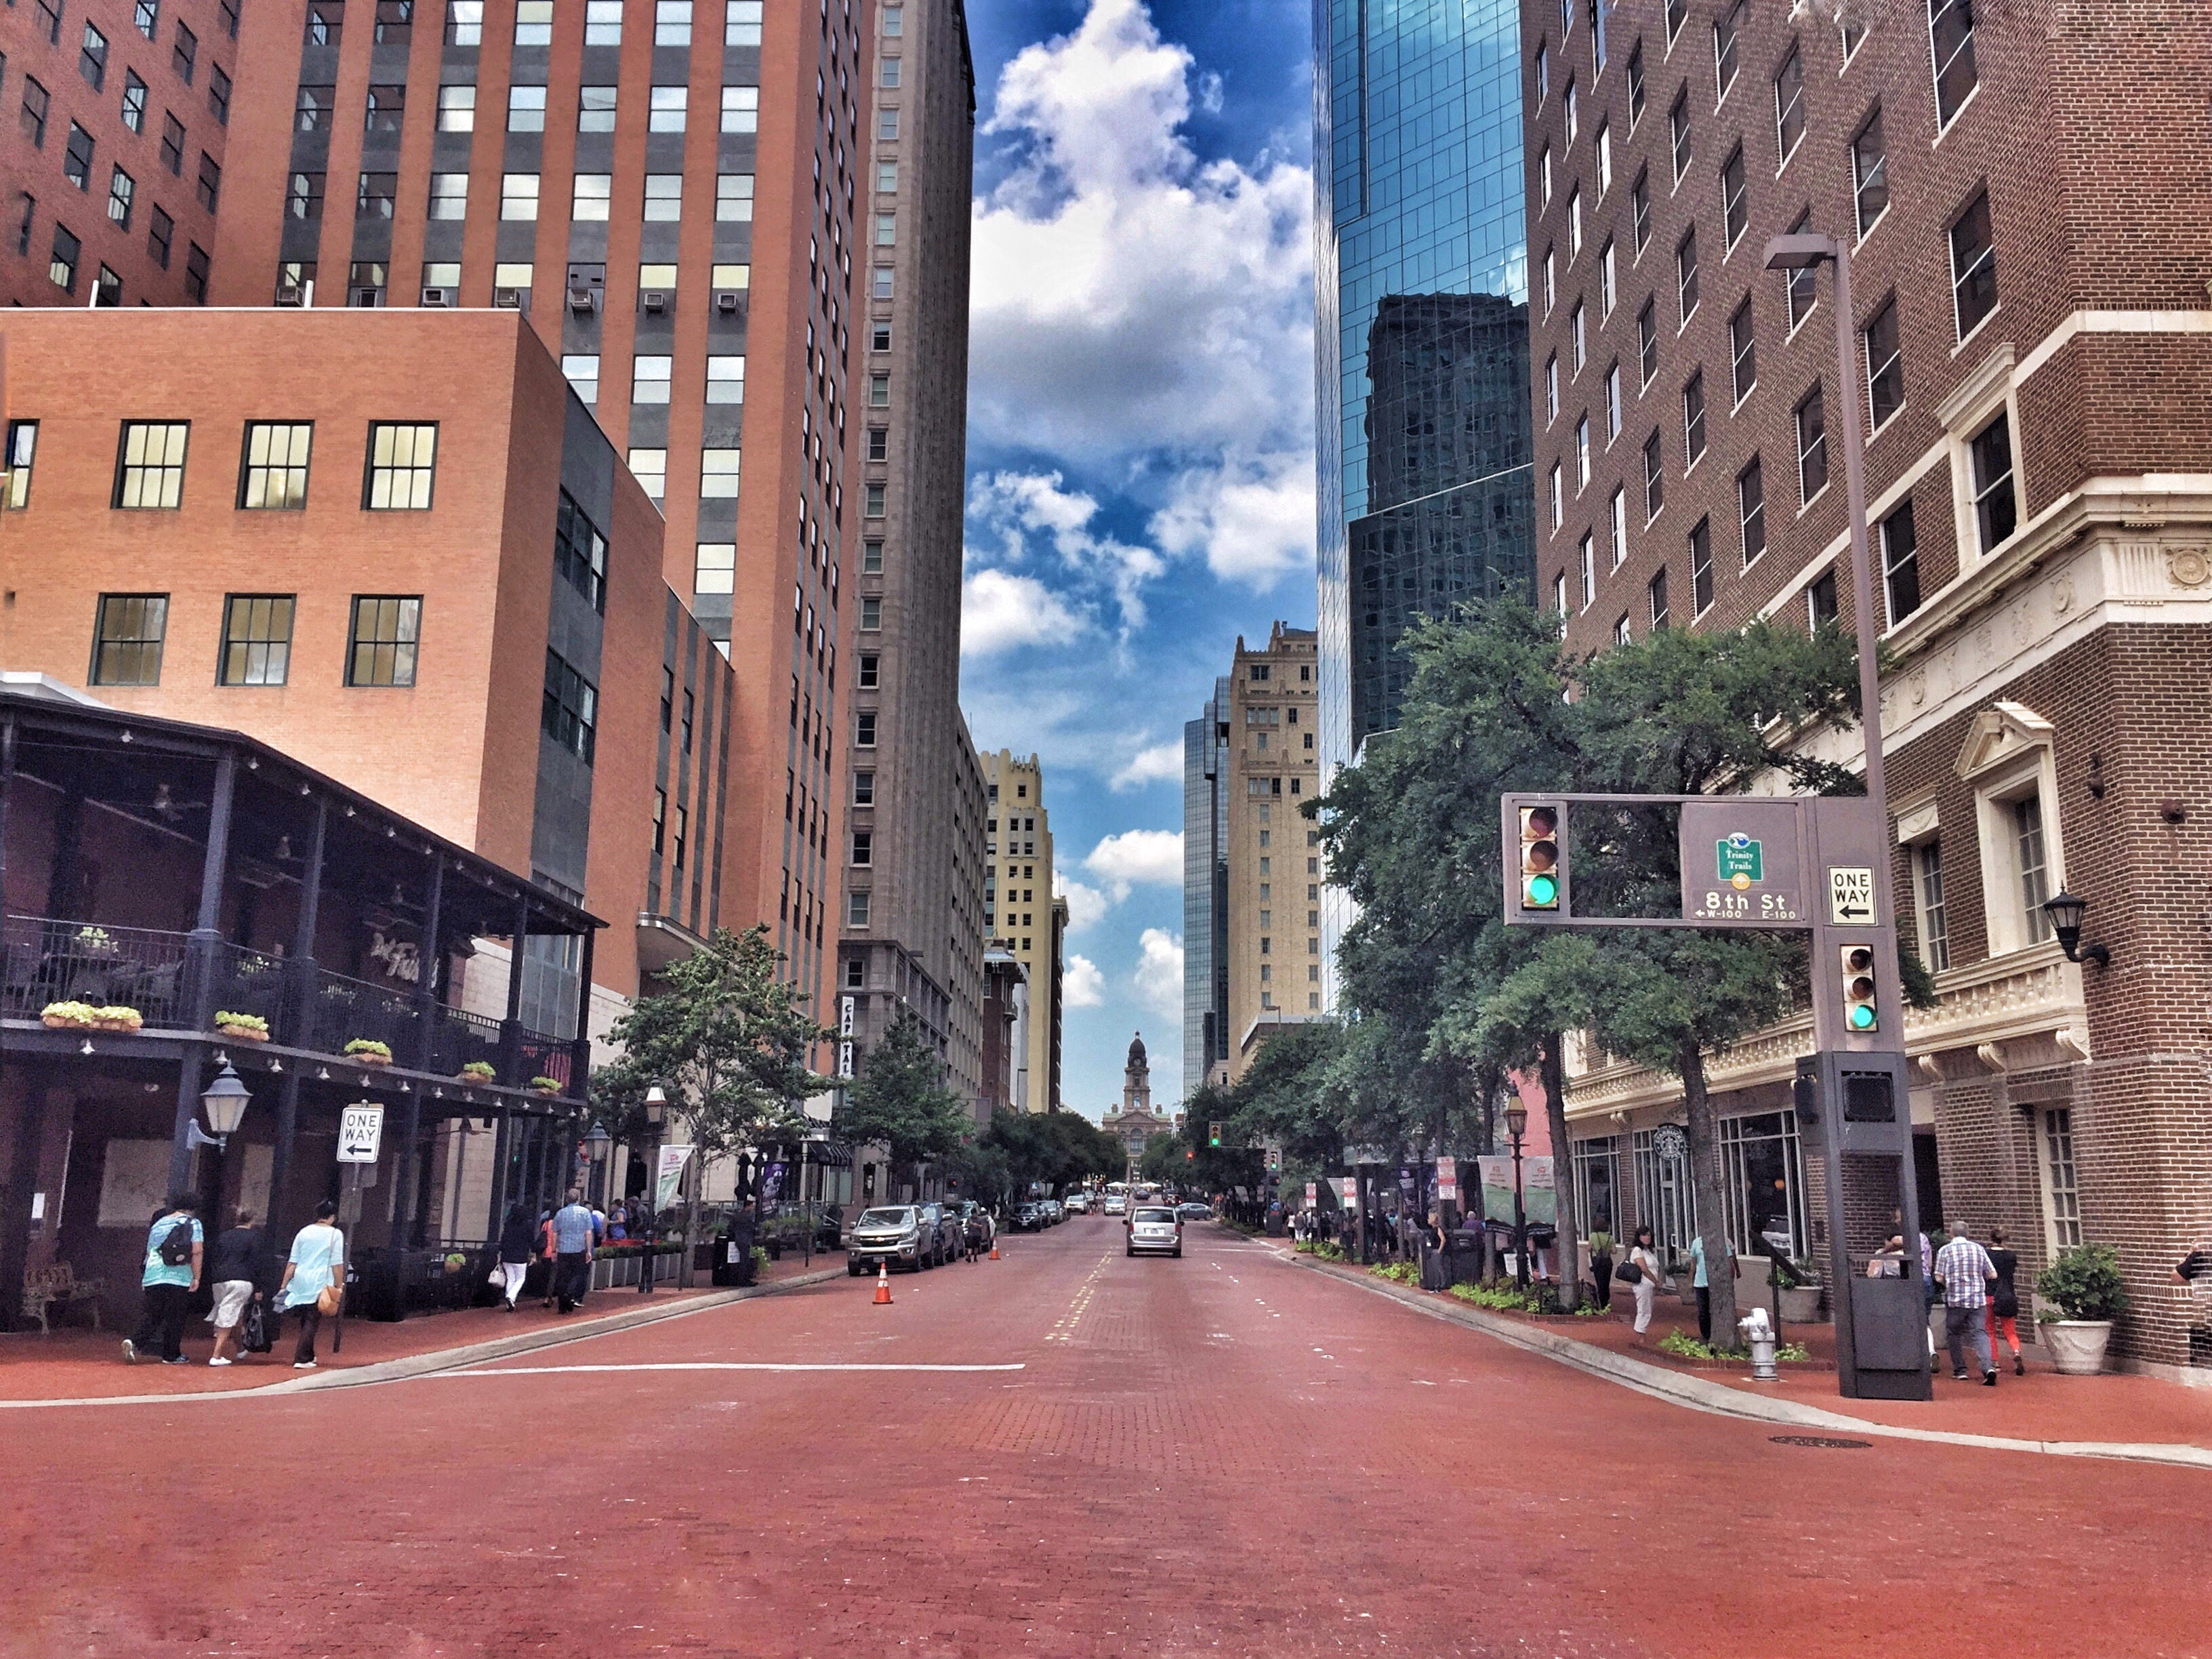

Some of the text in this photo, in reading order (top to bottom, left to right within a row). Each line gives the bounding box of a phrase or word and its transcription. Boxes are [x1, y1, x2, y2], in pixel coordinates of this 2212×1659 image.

[1726, 847, 1753, 861] Trinity
[1729, 861, 1752, 869] Trails
[1835, 874, 1869, 886] ONE
[1706, 891, 1784, 909] 8th St
[1835, 889, 1869, 902] WAY
[1707, 909, 1796, 919] W-100 E-100
[842, 1004, 853, 1073] CAPTAL
[347, 1114, 377, 1127] ONE
[345, 1128, 375, 1141] WAY
